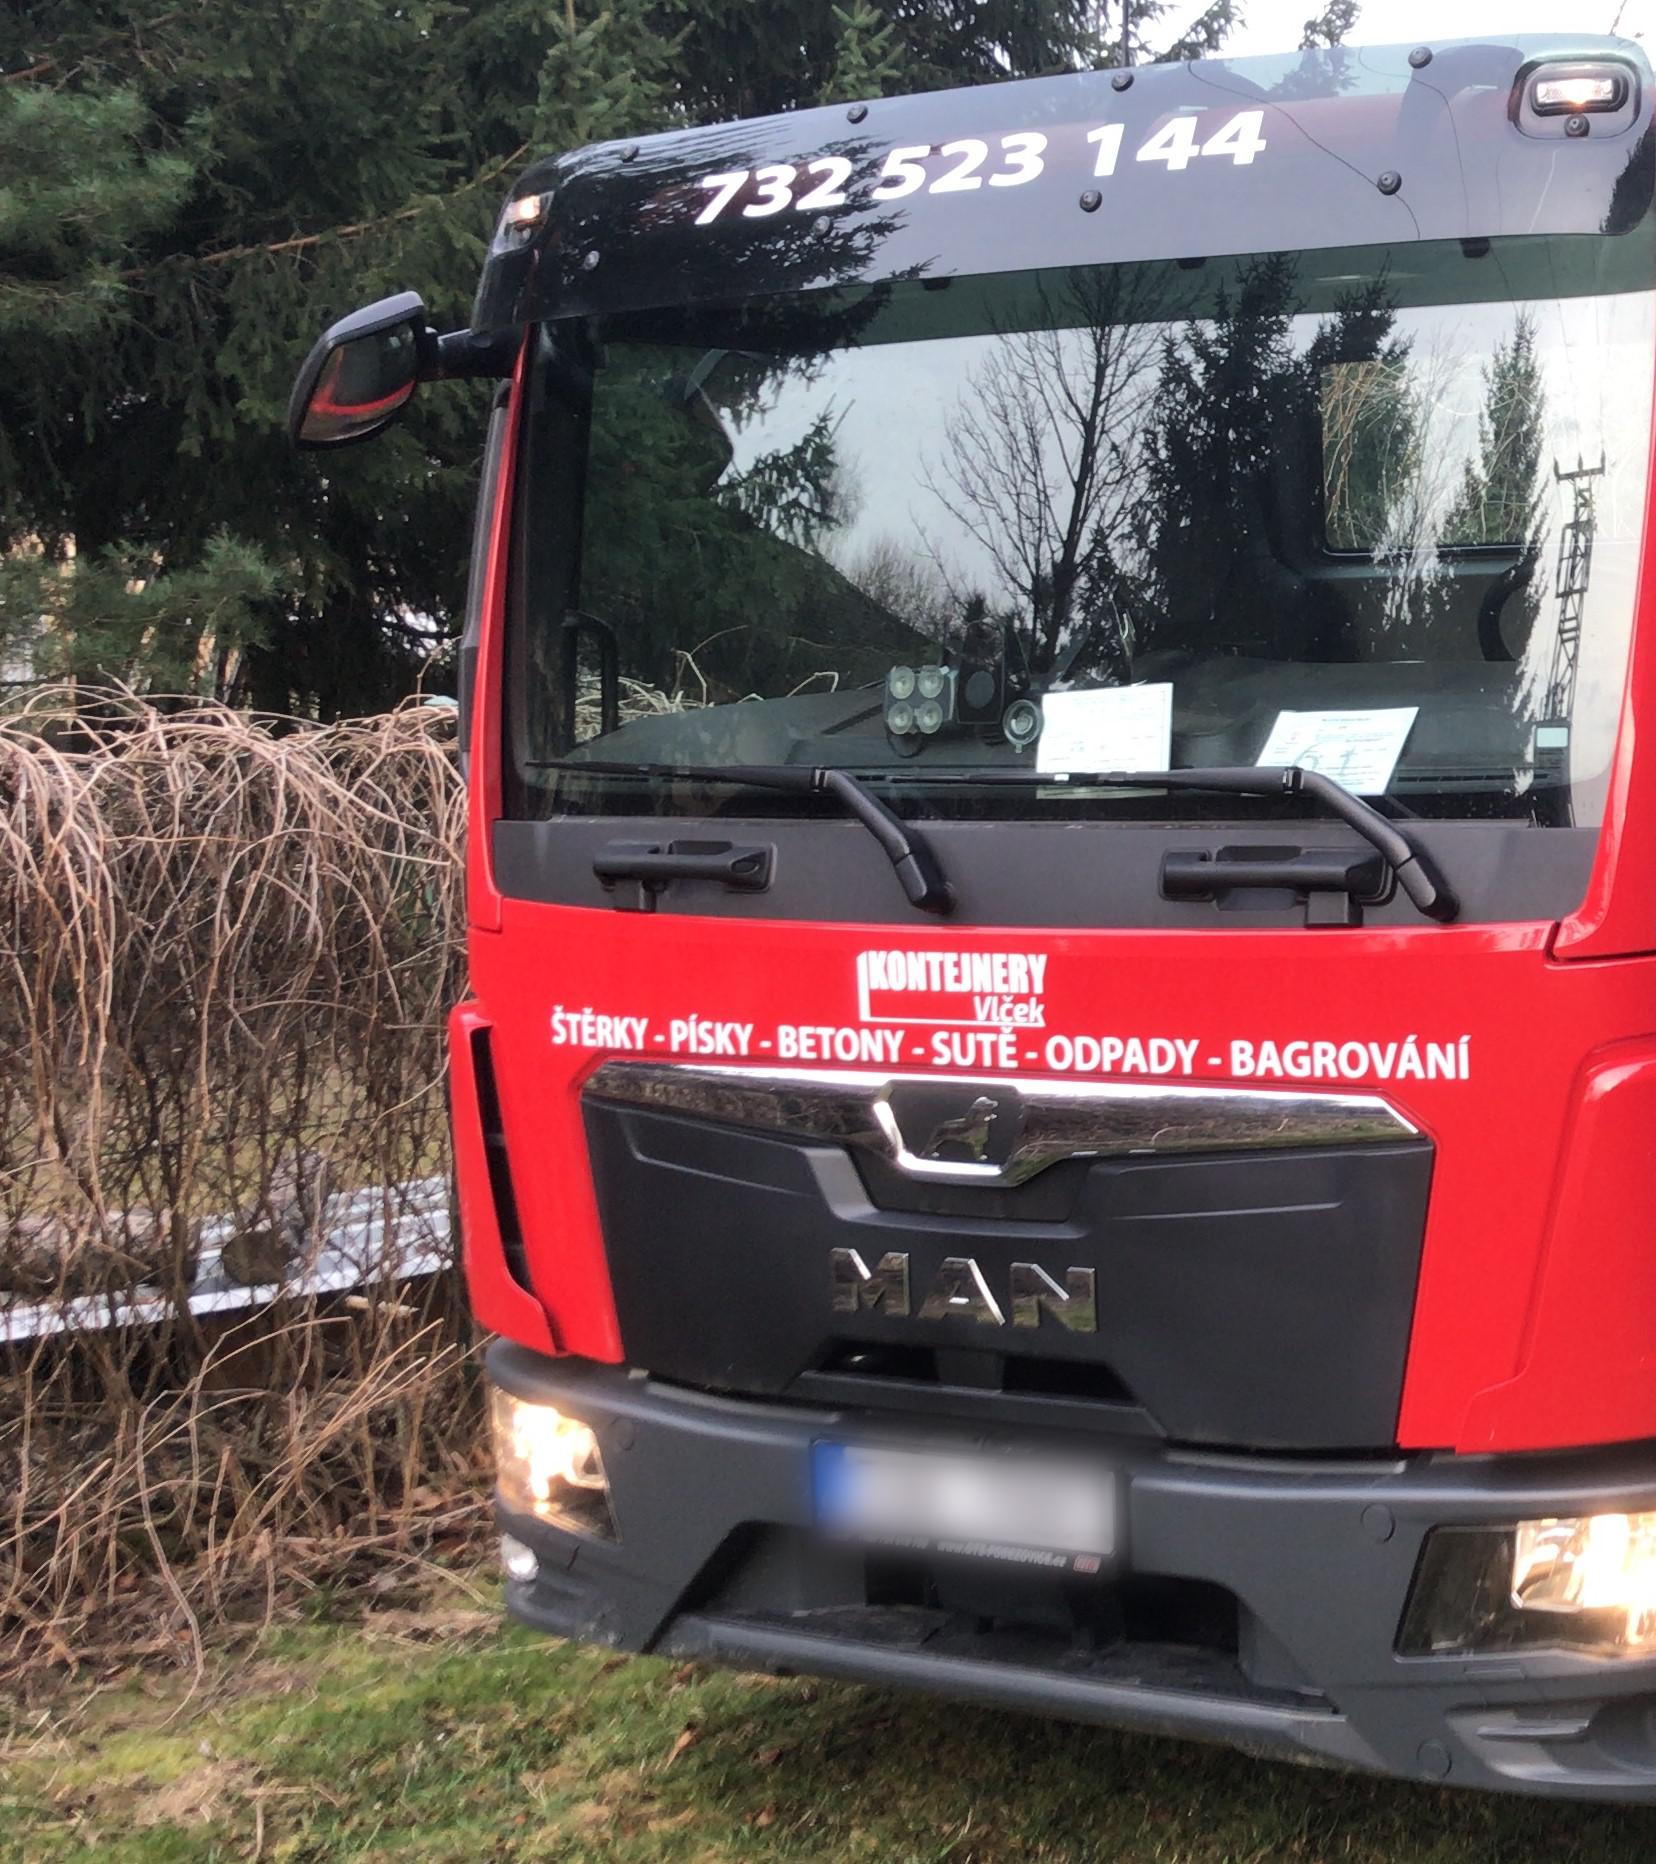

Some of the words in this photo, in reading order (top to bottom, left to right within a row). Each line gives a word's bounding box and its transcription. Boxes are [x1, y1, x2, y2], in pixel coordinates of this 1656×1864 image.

[694, 157, 853, 226] 732
[872, 132, 1048, 201] 523
[1086, 110, 1267, 177] 144
[867, 949, 1048, 995] KONTEJNERY
[973, 994, 1046, 1023] Vlček
[551, 1005, 648, 1050] ŠTĚRKY
[669, 1013, 754, 1056] PÍSKY
[778, 1025, 905, 1064] BETONY
[931, 1022, 1018, 1069] SUTĚ
[1045, 1034, 1200, 1075] ODPADY
[1230, 1034, 1472, 1080] BAGROVÁNÍ
[831, 1247, 1098, 1334] MAN
